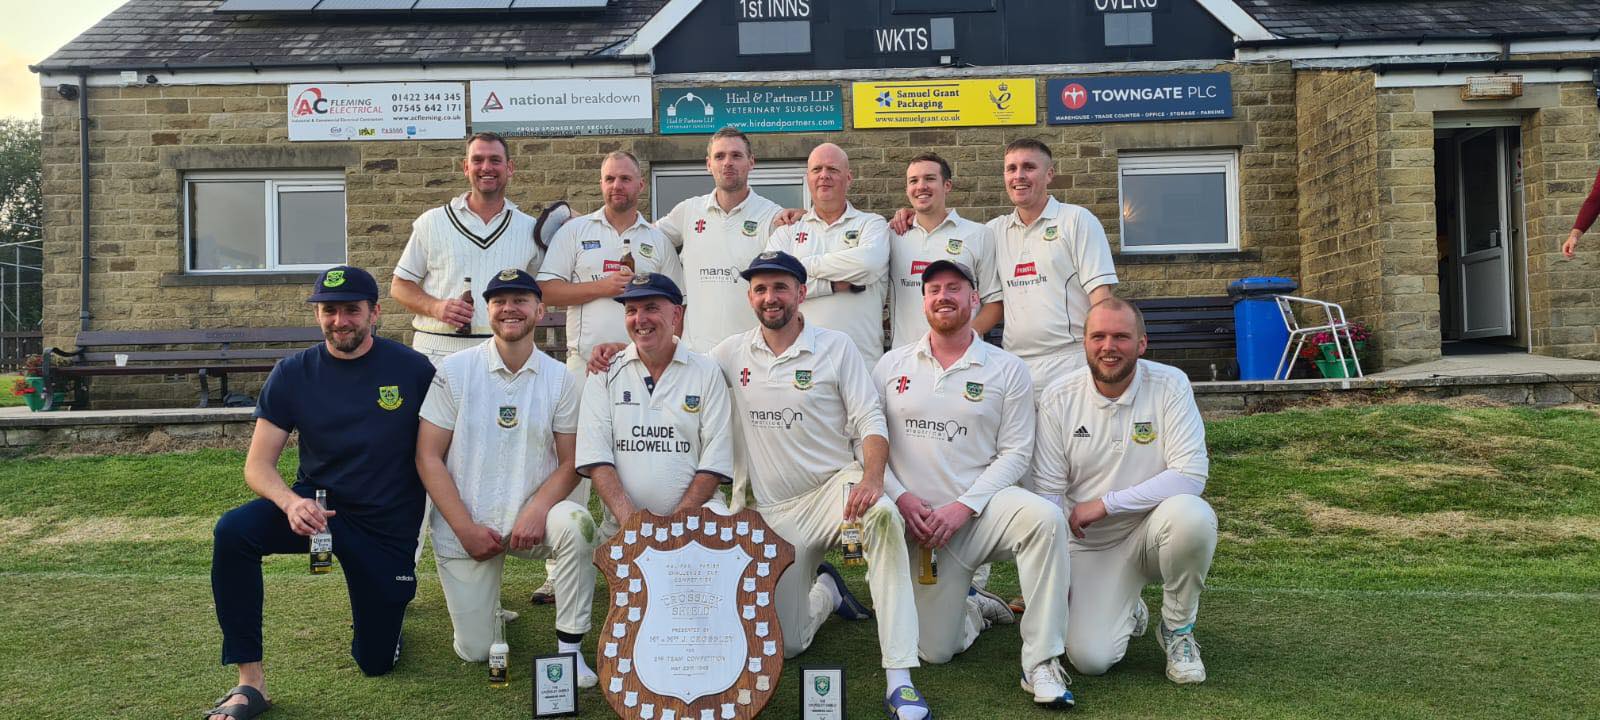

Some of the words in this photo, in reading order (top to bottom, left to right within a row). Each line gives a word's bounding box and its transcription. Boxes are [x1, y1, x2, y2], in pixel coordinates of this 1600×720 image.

[739, 0, 763, 18] 1st
[768, 0, 810, 17] INNS
[876, 27, 928, 51] WKTS
[392, 93, 420, 101] 01422
[424, 93, 440, 101] 344
[444, 93, 461, 101] 345
[510, 93, 567, 106] national
[571, 91, 640, 104] breakdown
[726, 91, 750, 103] Hird
[753, 92, 762, 103] &
[765, 92, 808, 103] Partners
[810, 90, 834, 102] LLP
[897, 89, 930, 98] Samuel
[933, 89, 960, 97] Grant
[1091, 87, 1183, 102] TOWNGATE
[1188, 85, 1217, 99] PLC
[330, 98, 372, 106] FLEMING
[897, 99, 943, 109] Packaging
[329, 106, 382, 114] ELECTRICAL
[392, 104, 421, 112] 07545
[424, 104, 442, 112] 642
[726, 106, 780, 114] VETERINARY
[785, 105, 834, 113] SURGEONS
[726, 118, 835, 129] www.hirdandpartners.com
[875, 114, 960, 123] www.samuelgrant.co.uk
[632, 425, 674, 438] CLAUDE
[616, 439, 672, 453] HELLOWELL
[675, 441, 690, 453] LTD
[672, 607, 710, 616] SHIELD
